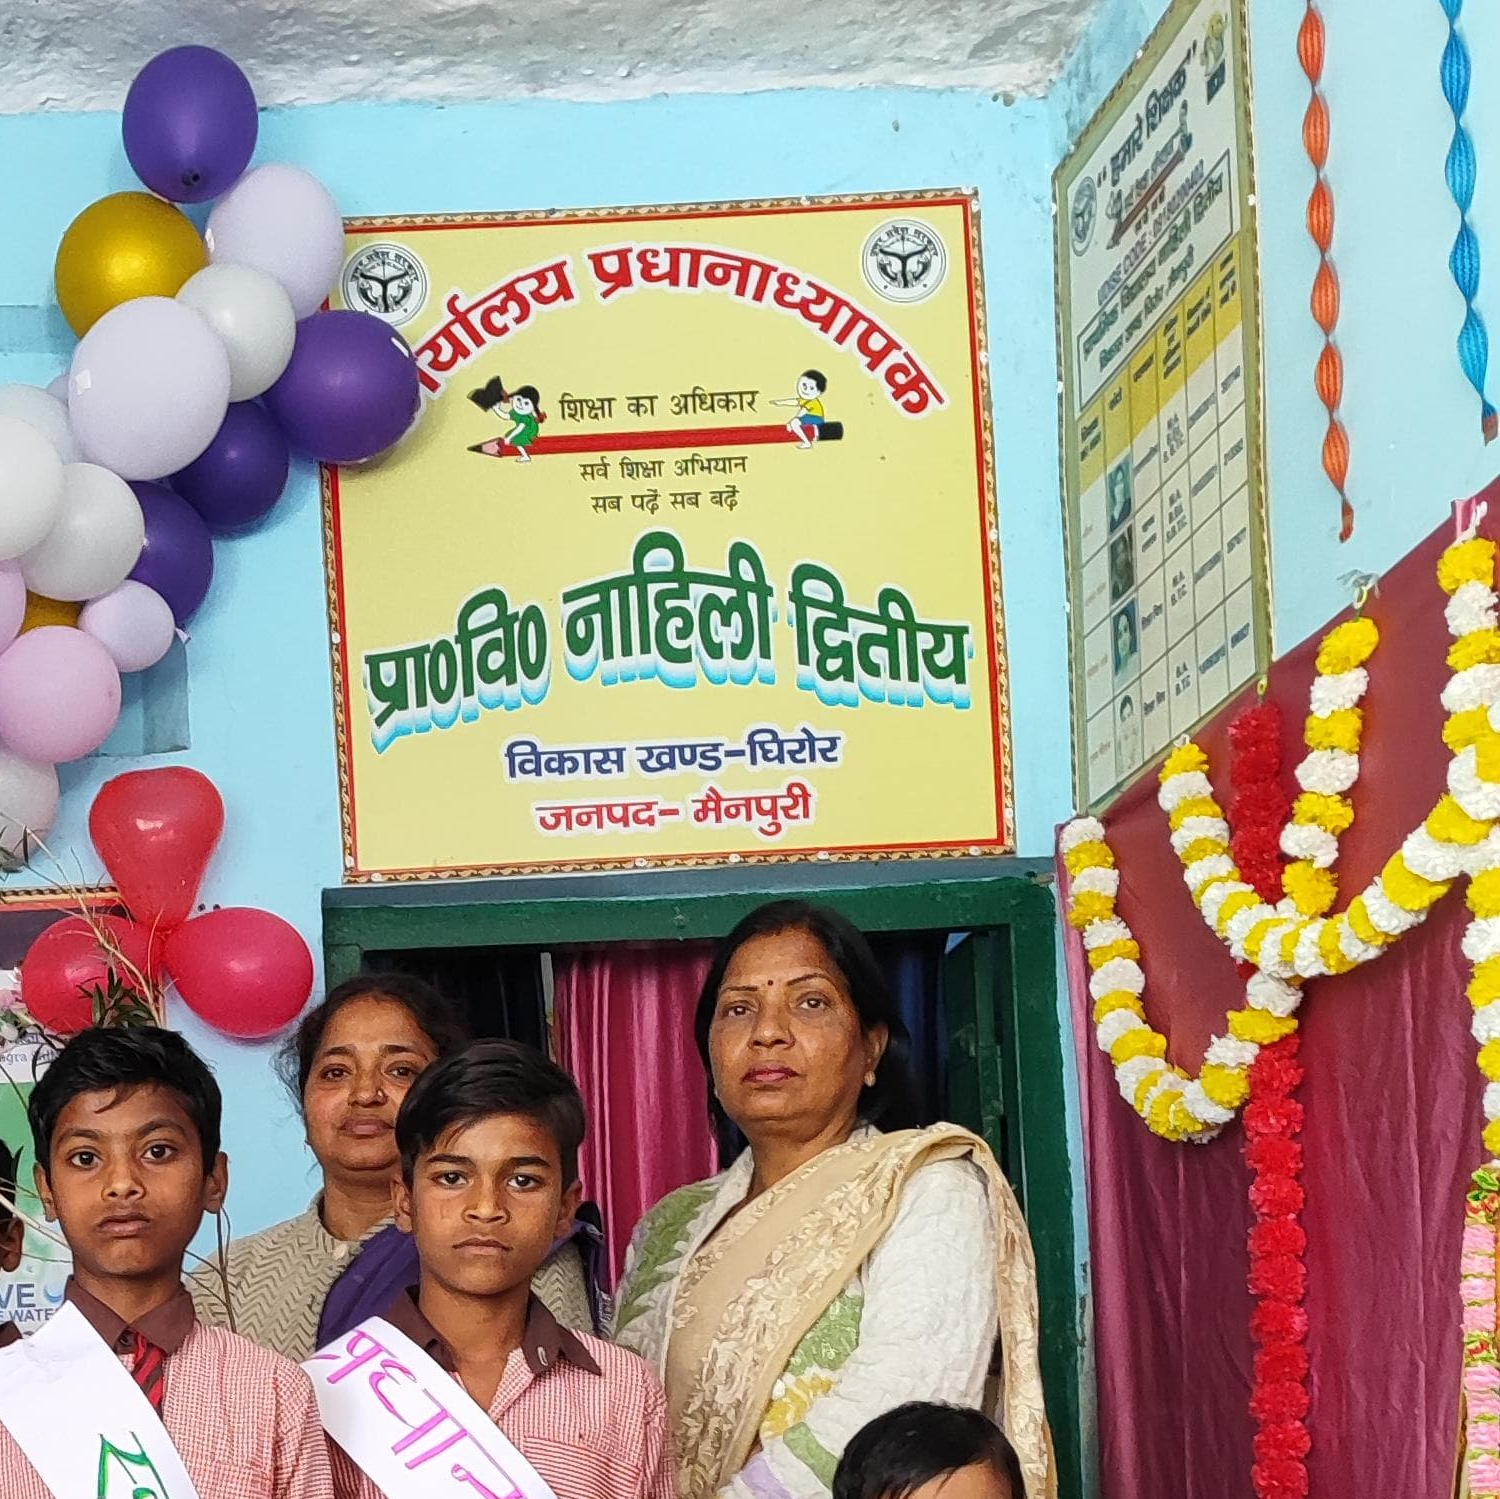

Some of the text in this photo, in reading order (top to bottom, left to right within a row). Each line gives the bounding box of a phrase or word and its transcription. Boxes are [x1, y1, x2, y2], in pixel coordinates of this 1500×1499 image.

[415, 246, 944, 415] र्यालय प्रधानाध्यापक
[558, 385, 760, 423] शिक्षा का अधिकार
[578, 452, 749, 482] सर्व शिक्षा अभियान
[590, 494, 623, 515] सब
[668, 491, 702, 511] सब
[563, 531, 775, 664] नाहिली
[790, 563, 970, 684] द्वितीय
[505, 740, 627, 778] विकास
[694, 782, 812, 837] मैनपुरी
[8, 1308, 57, 1322] WATE
